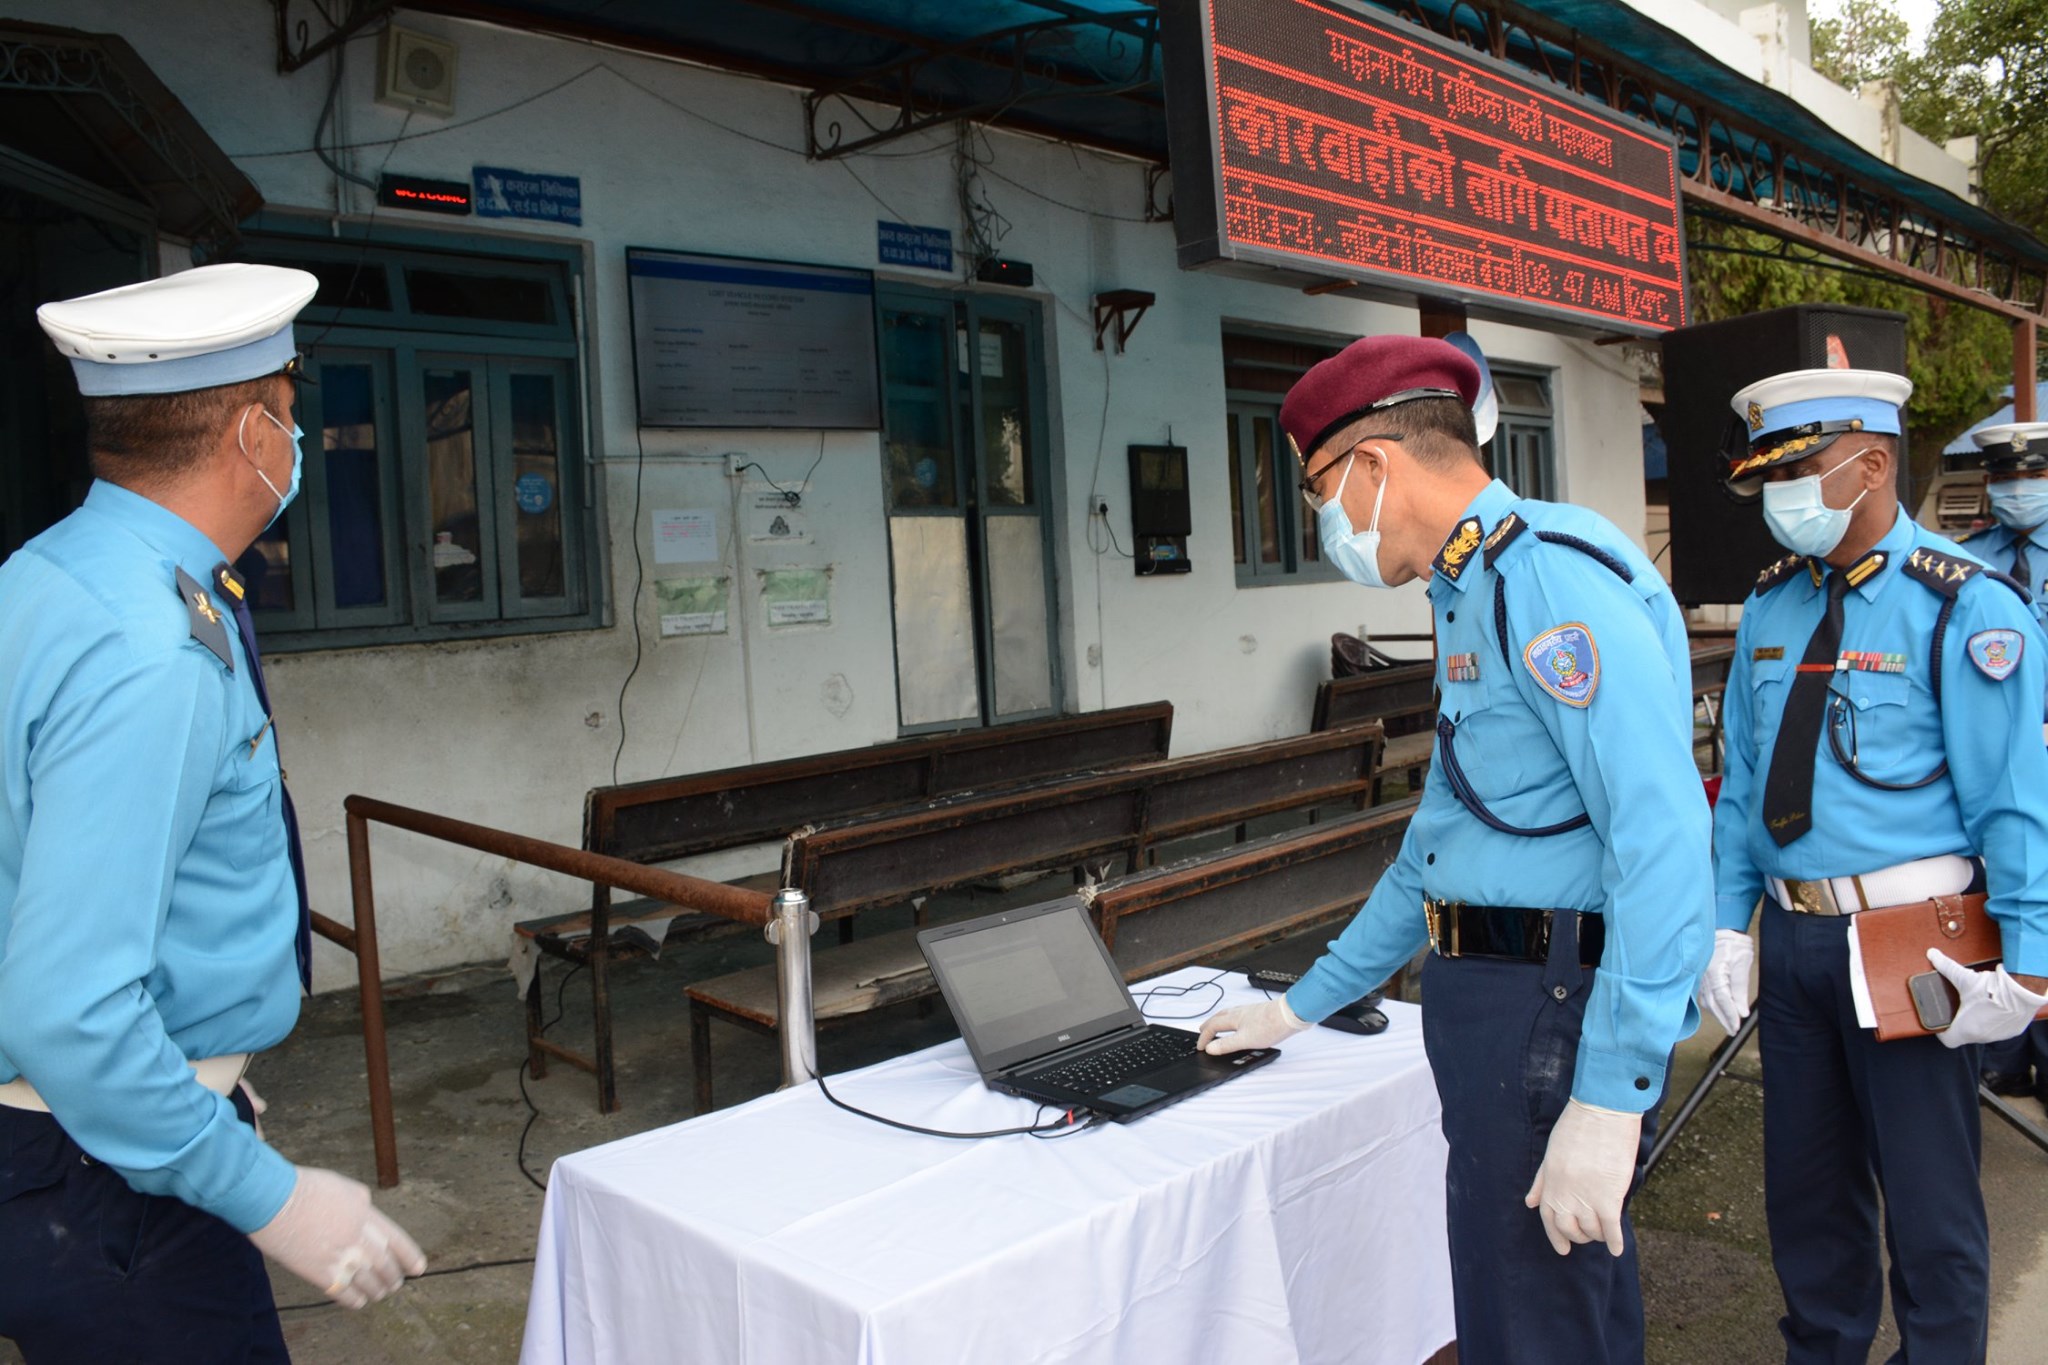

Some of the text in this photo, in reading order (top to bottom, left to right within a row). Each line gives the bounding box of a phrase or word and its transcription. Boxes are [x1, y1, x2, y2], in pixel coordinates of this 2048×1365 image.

[1325, 28, 1433, 102] महानगरीय
[1437, 70, 1502, 124] ट्राफिक
[1461, 150, 1538, 231] लागि
[1537, 184, 1649, 263] यातायात
[1591, 277, 1621, 312] AM
